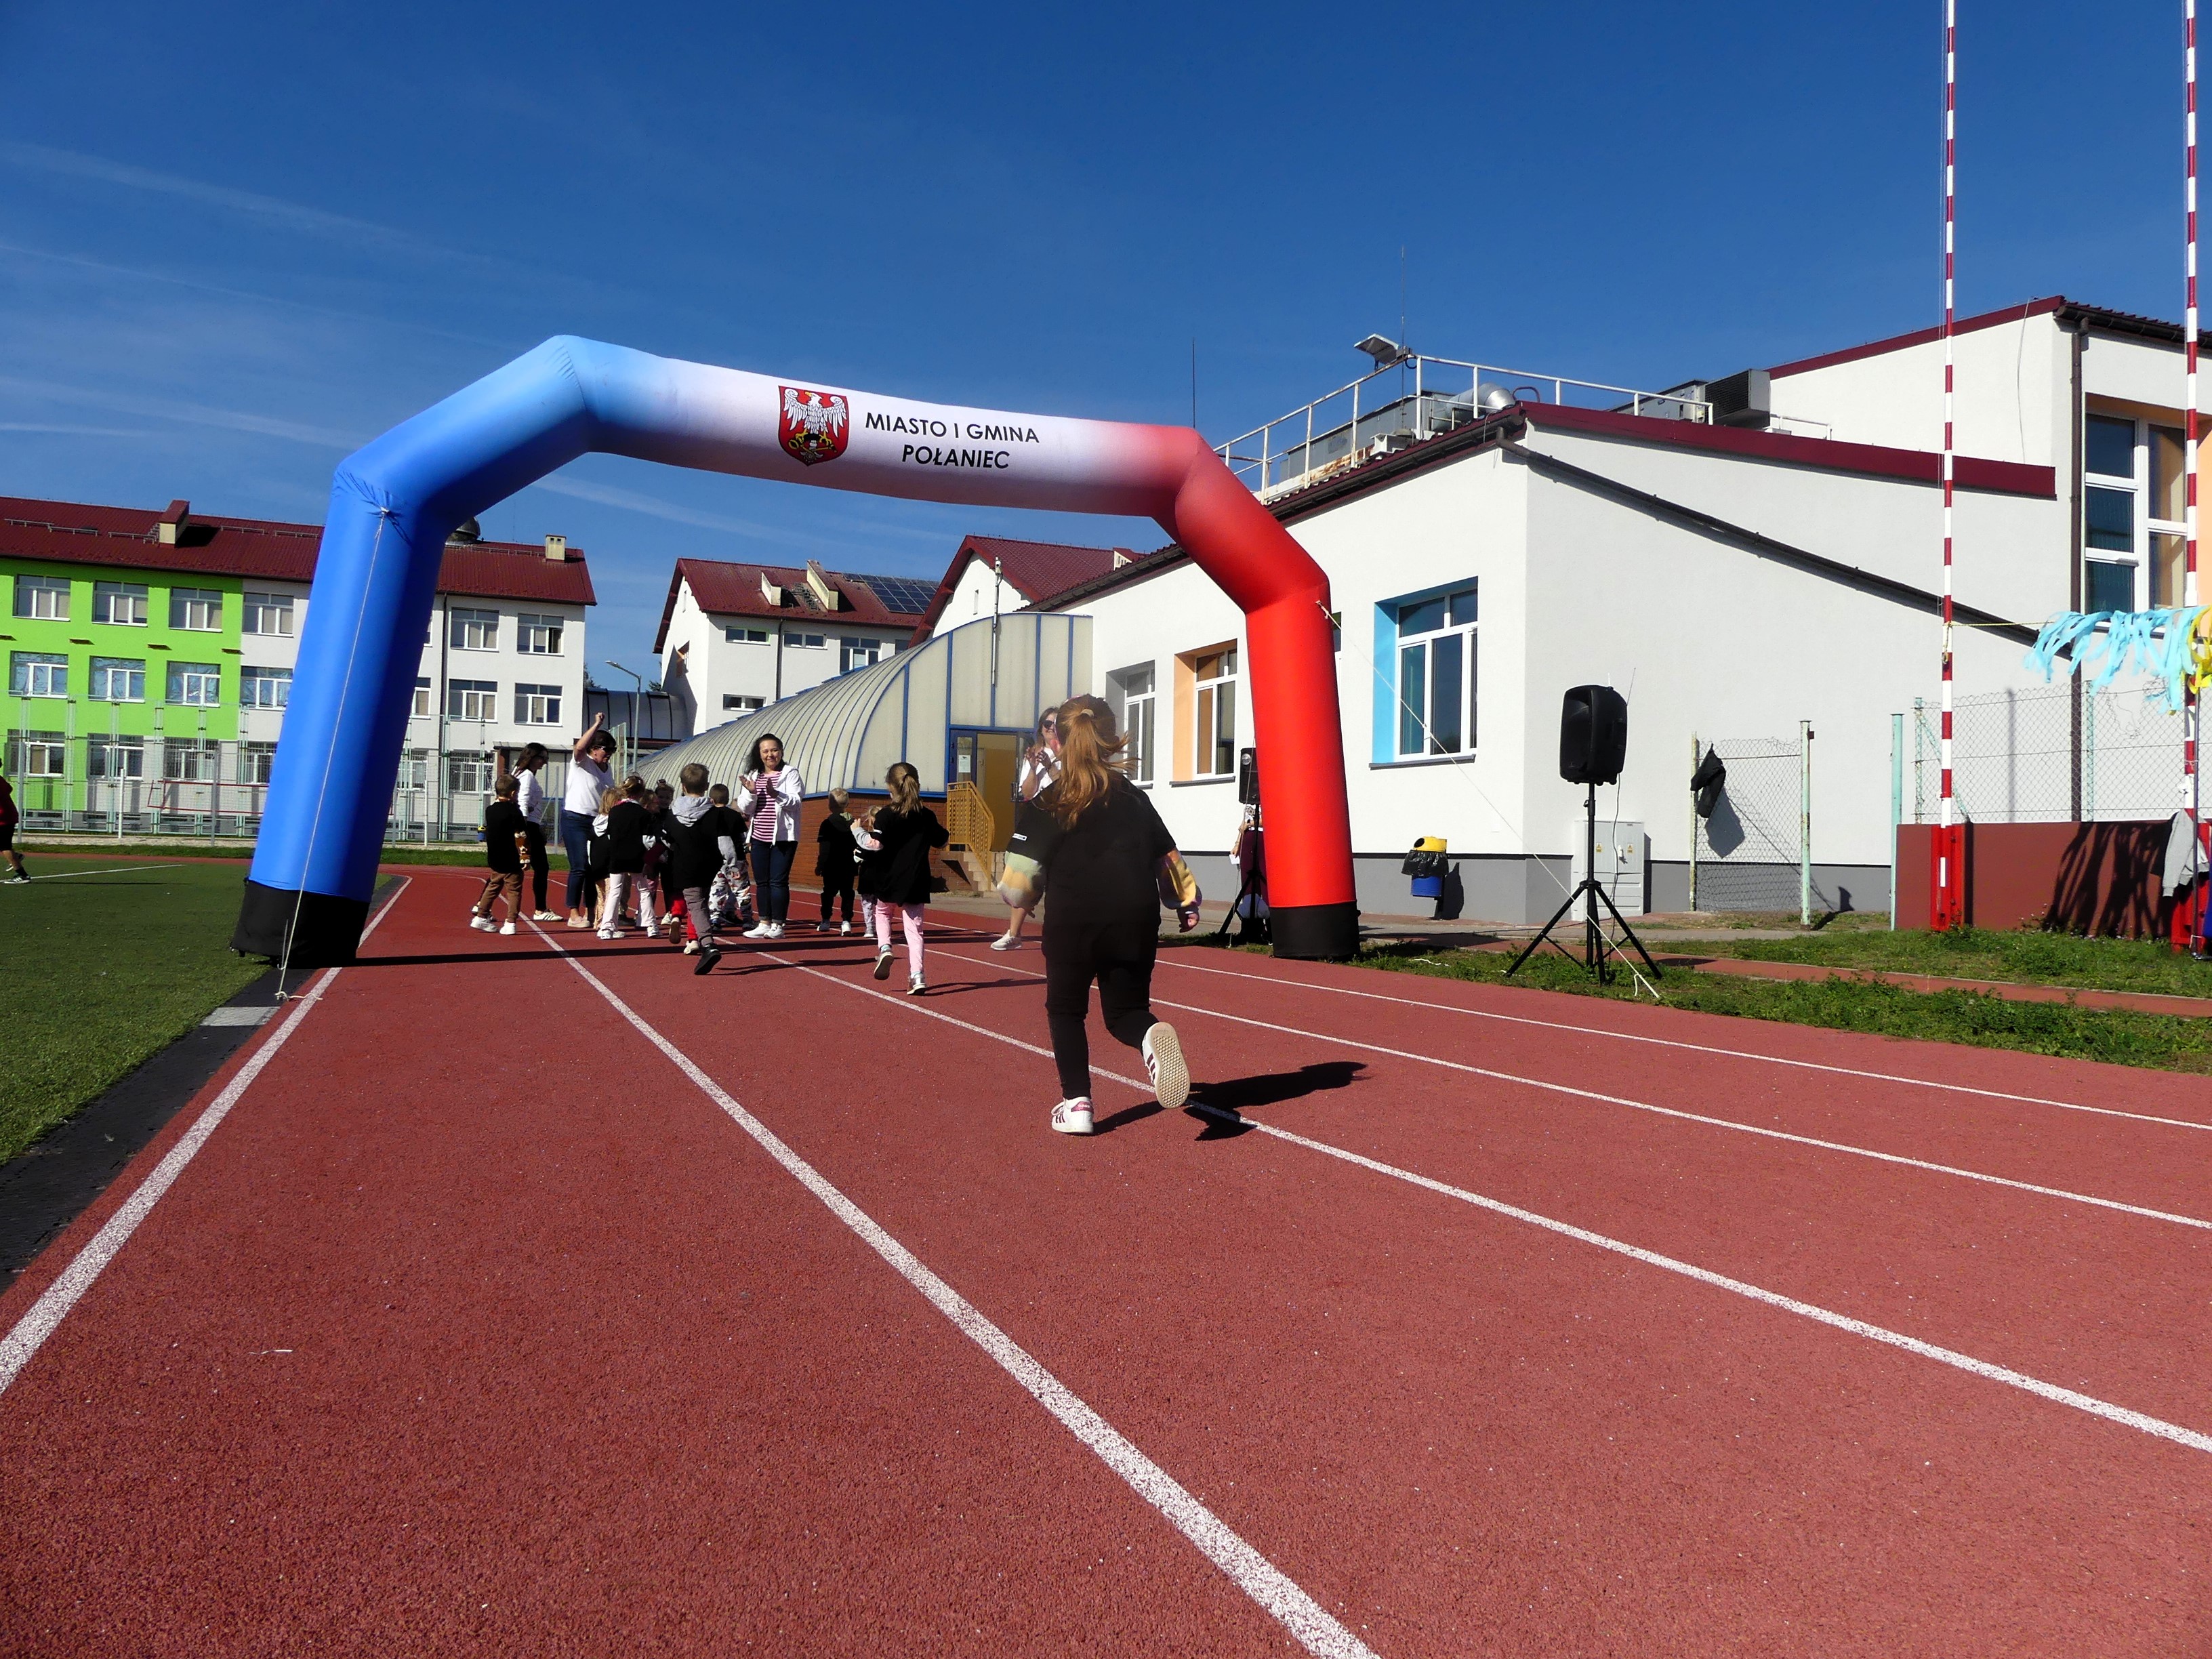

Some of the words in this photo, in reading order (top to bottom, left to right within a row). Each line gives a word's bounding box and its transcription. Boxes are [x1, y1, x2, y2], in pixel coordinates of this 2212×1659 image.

[865, 412, 947, 438] MIASTO
[954, 422, 959, 438] I
[966, 424, 1040, 443] GMINA
[902, 444, 1010, 469] POŁANIEC
